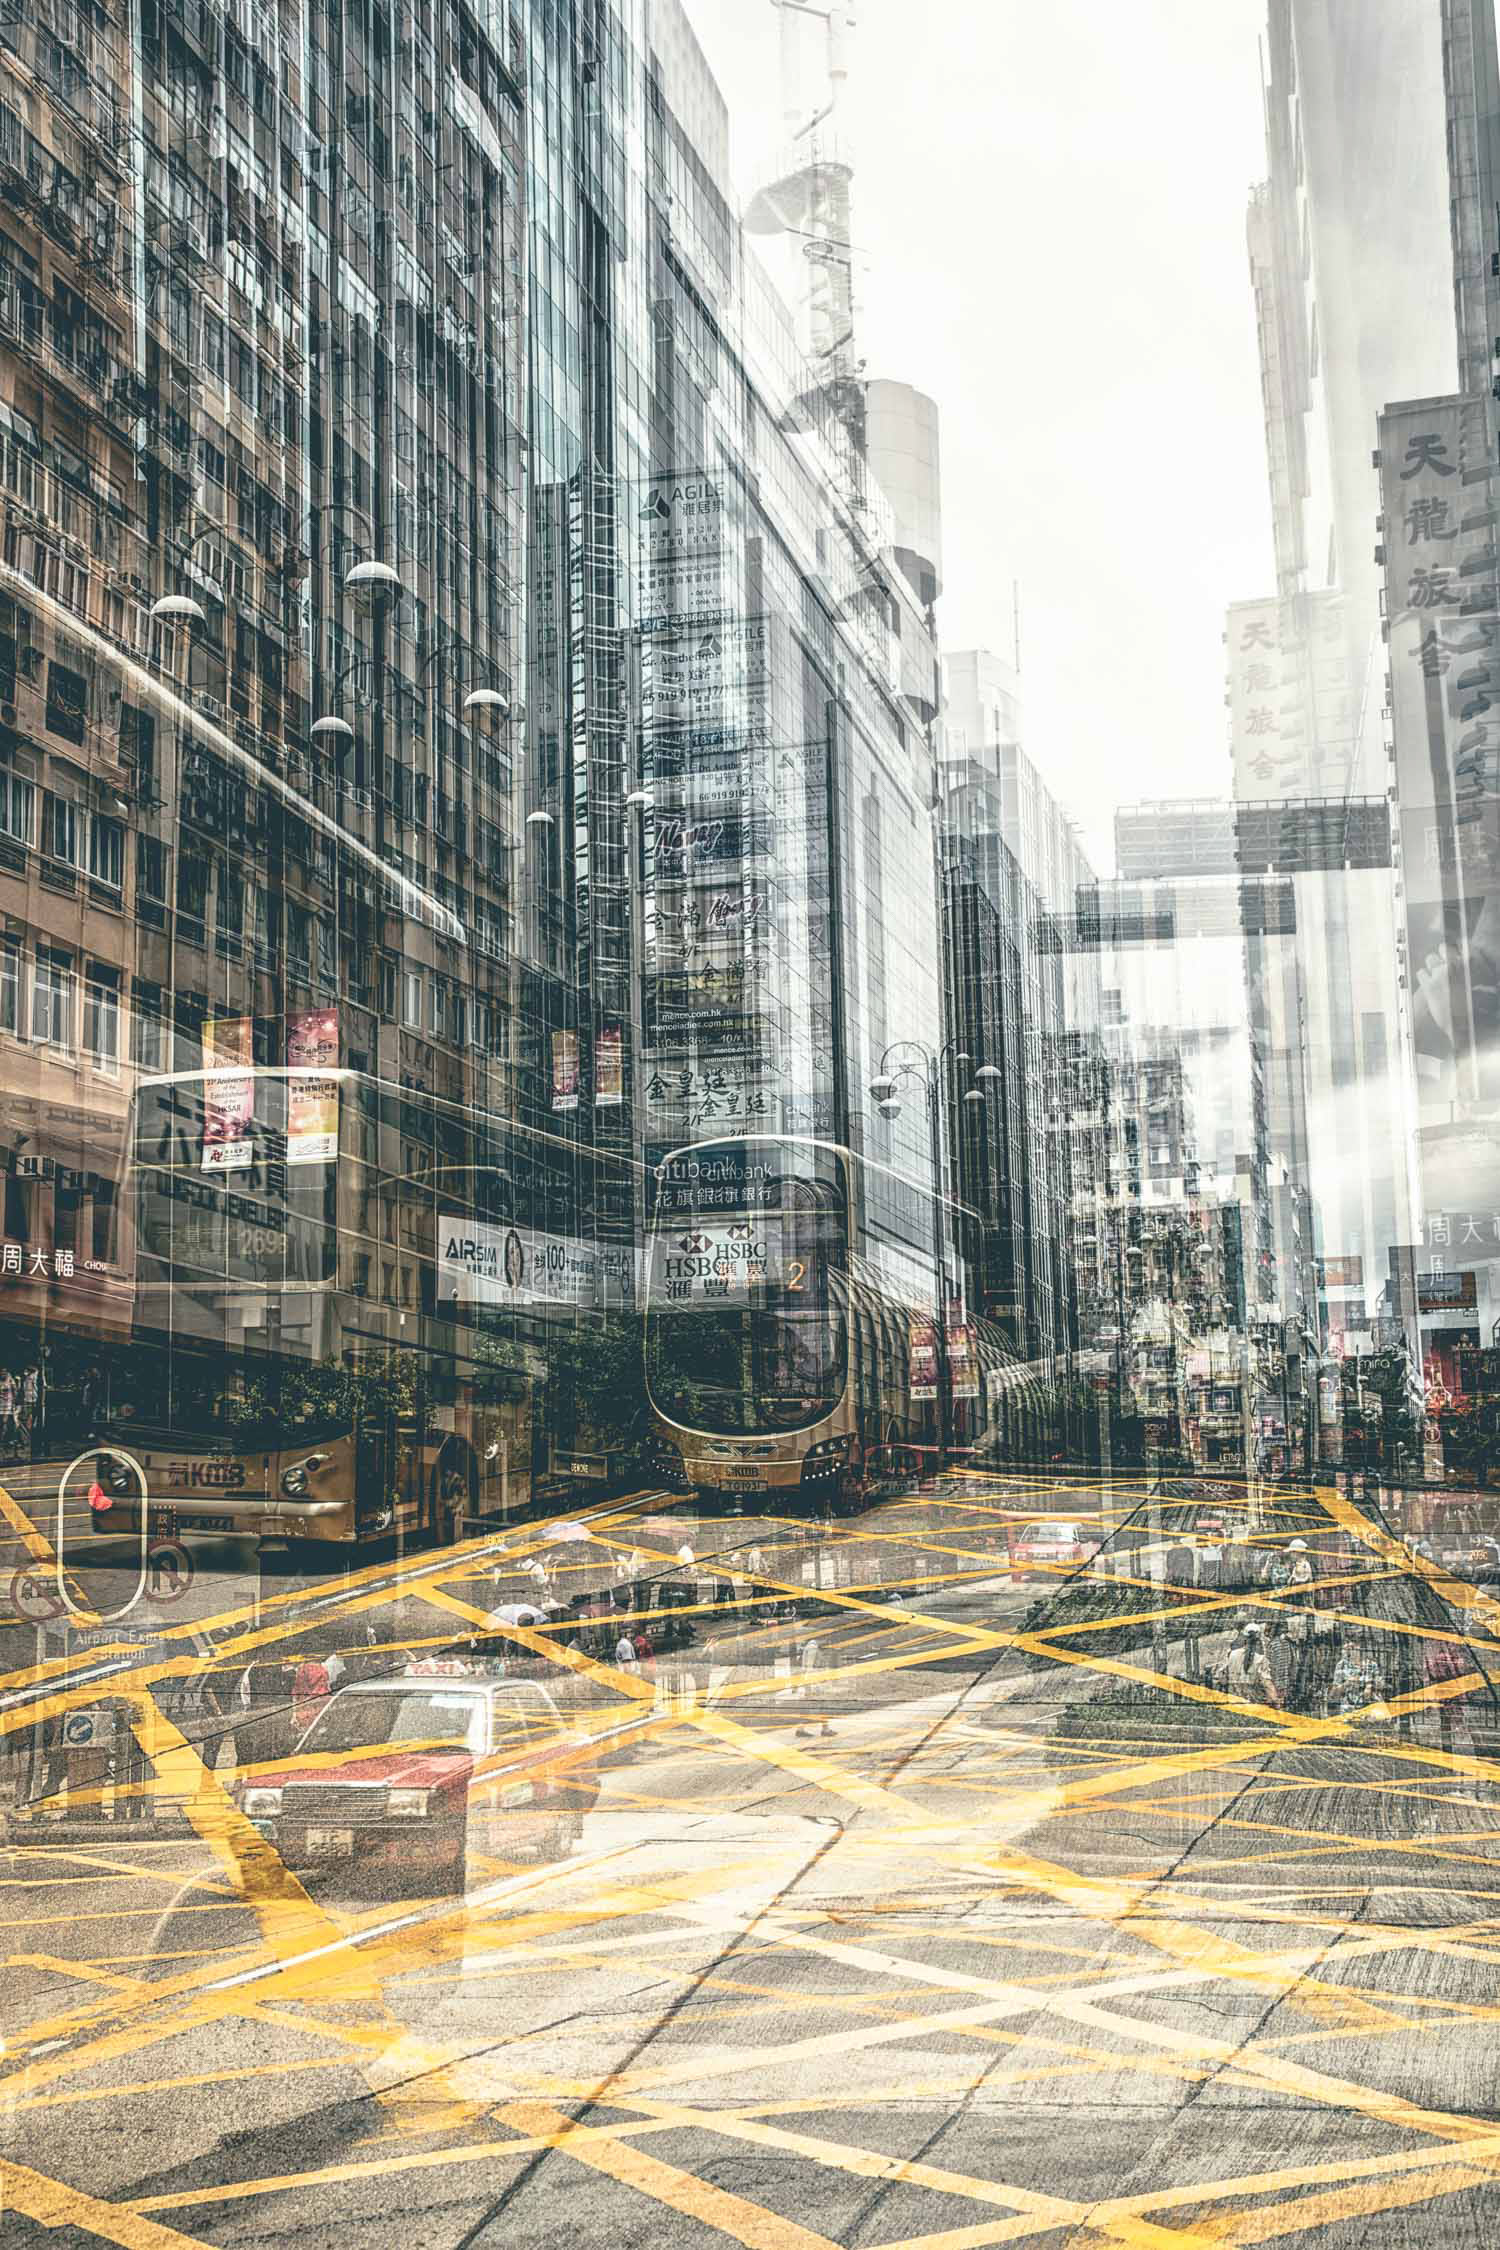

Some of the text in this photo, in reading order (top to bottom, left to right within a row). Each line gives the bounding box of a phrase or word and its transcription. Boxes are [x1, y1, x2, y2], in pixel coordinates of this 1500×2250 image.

[671, 482, 724, 502] AGILE
[661, 1008, 721, 1022] mence.com.hk
[643, 1069, 730, 1101] 金皇廷
[698, 1092, 769, 1118] 金皇廷
[681, 1114, 705, 1127] 2/F
[653, 1156, 736, 1181] citibank
[706, 1162, 774, 1182] citibank
[2, 1244, 74, 1277] 周大福
[715, 1241, 768, 1260] HSBC
[664, 1256, 729, 1279] HSBC
[1360, 1358, 1391, 1369] mira
[76, 1632, 120, 1647] Airport
